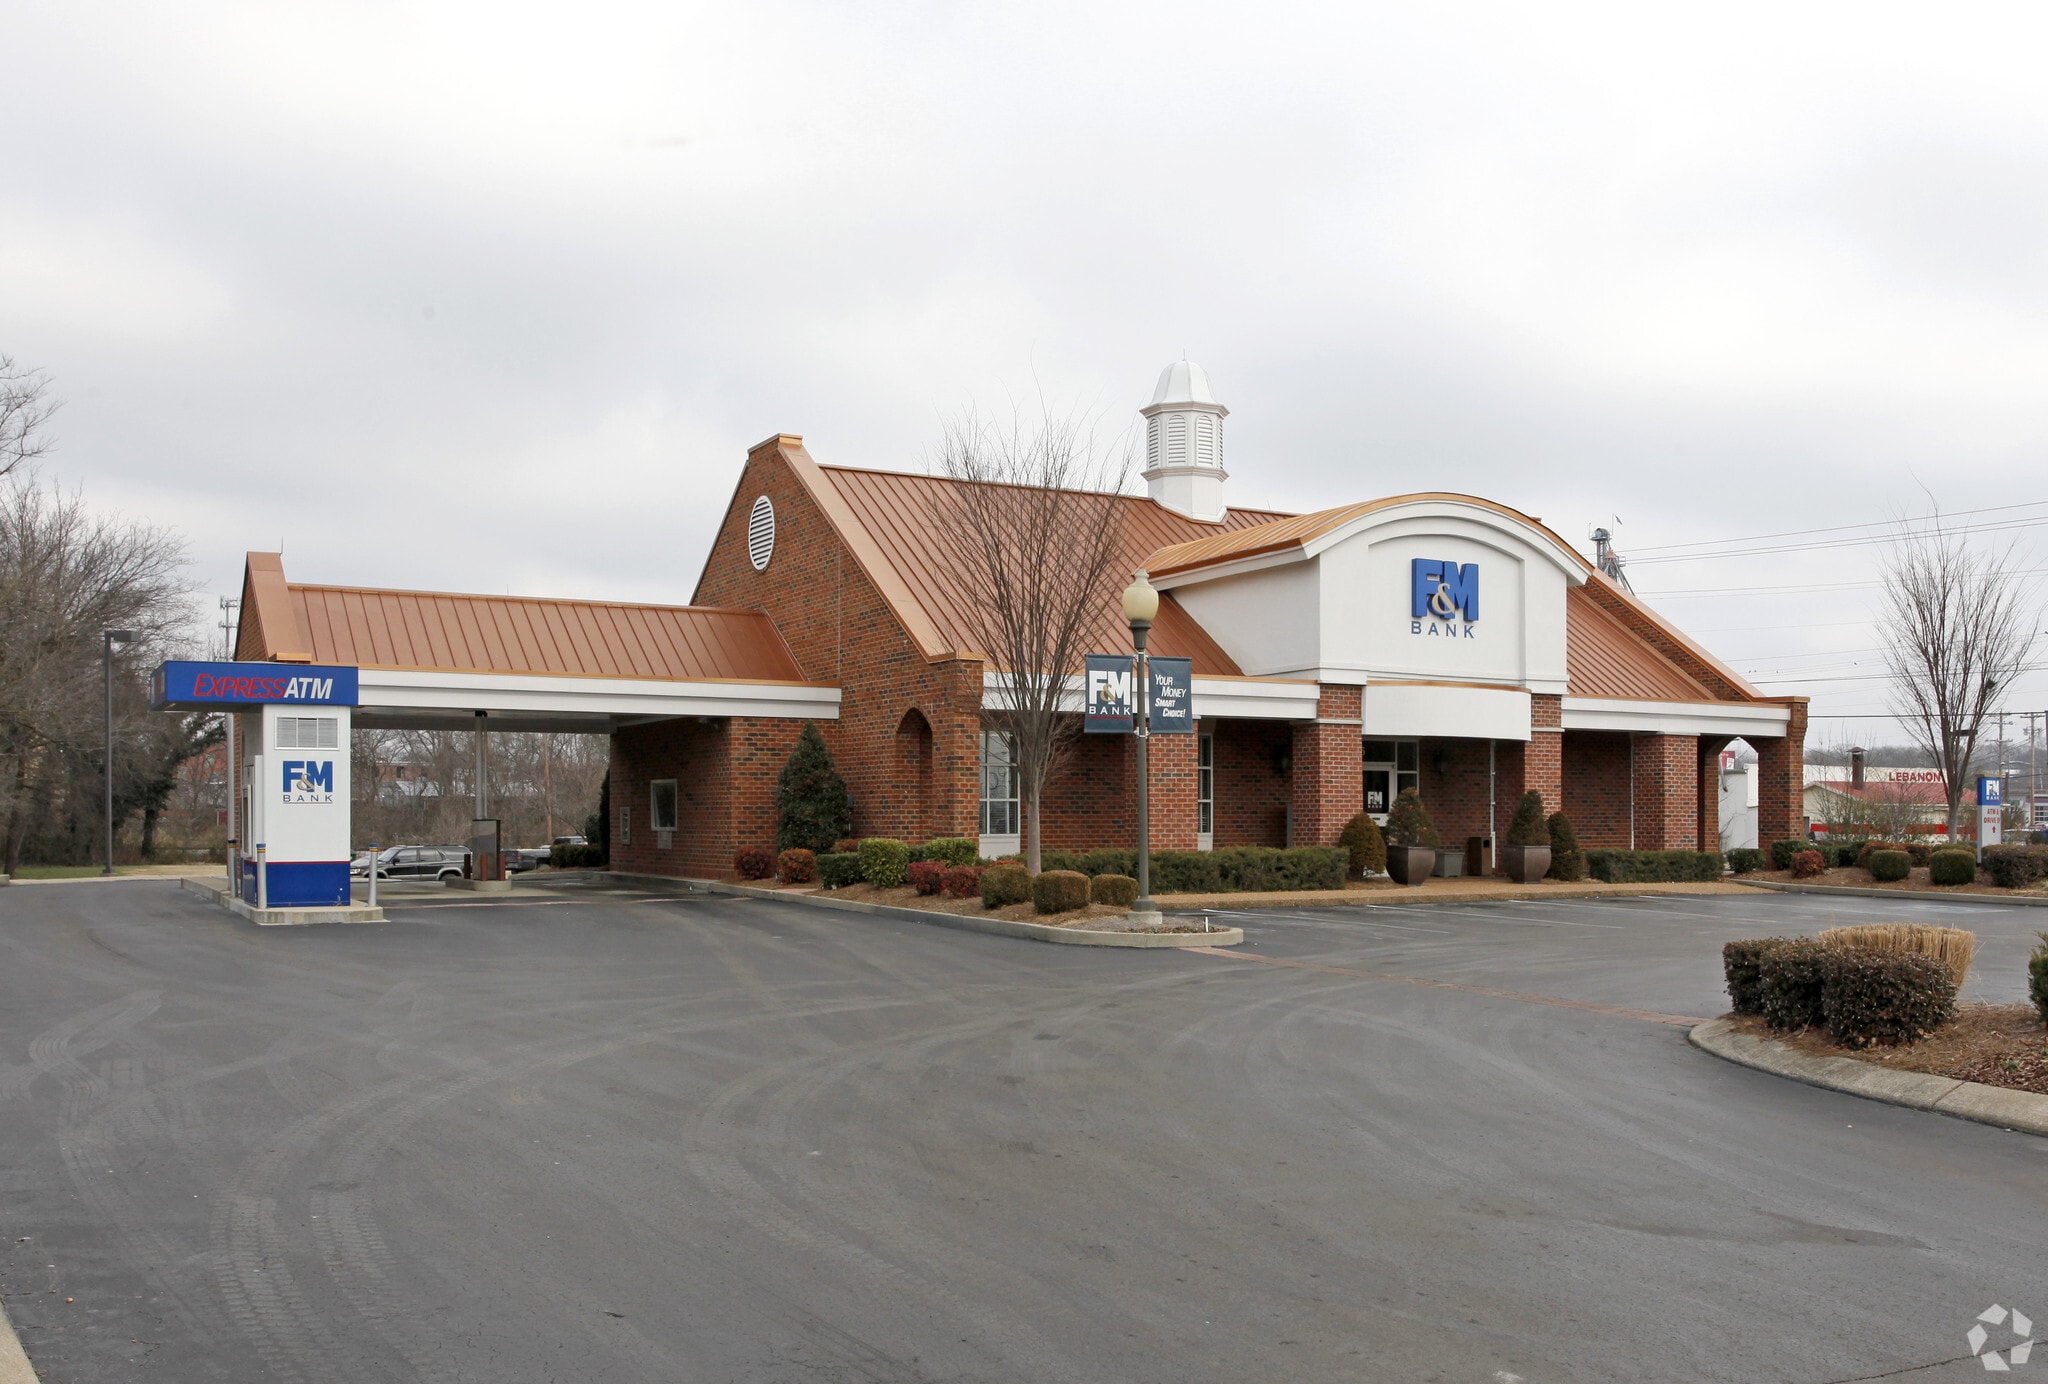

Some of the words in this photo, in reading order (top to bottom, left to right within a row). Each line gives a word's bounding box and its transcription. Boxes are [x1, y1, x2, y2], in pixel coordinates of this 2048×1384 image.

[1411, 558, 1479, 622] F&M
[1411, 621, 1474, 638] BANK
[1155, 674, 1174, 686] YOUR
[1088, 670, 1131, 706] F&M
[1161, 686, 1187, 698] MONEY
[1154, 698, 1176, 708] SMART
[1088, 706, 1131, 716] BANK
[282, 761, 333, 793] F&M
[1888, 771, 1941, 782] LEBANON
[282, 794, 334, 803] BANK
